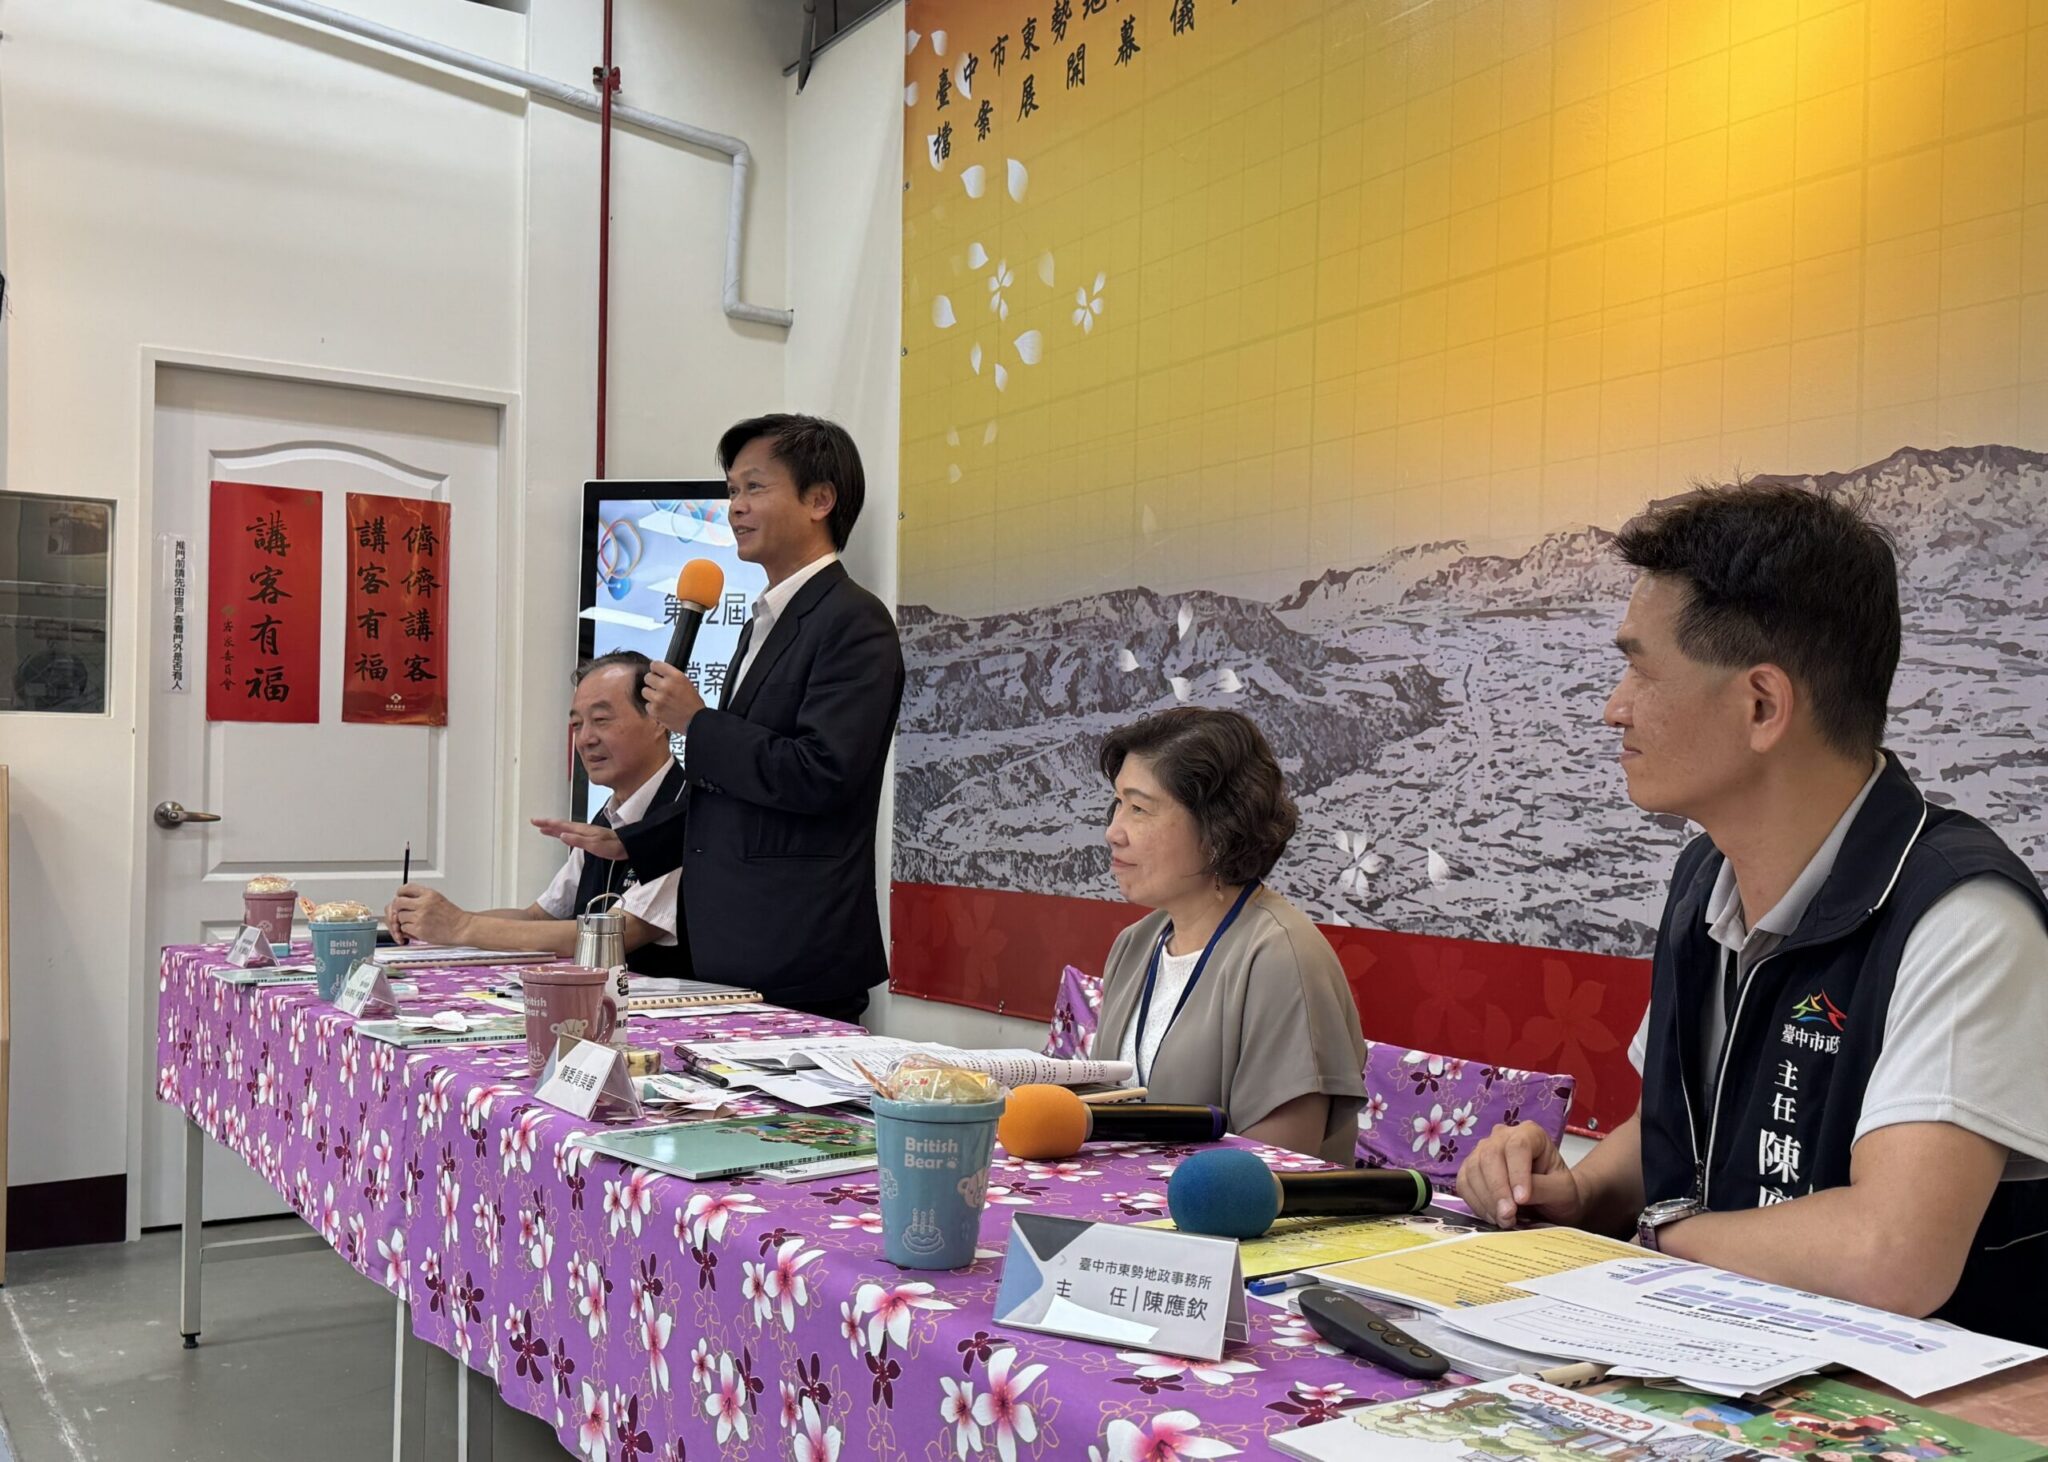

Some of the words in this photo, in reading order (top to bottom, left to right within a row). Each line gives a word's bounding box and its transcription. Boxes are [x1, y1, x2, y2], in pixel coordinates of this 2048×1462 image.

[936, 0, 1121, 111] 臺中市東勢地
[933, 0, 1236, 164] 檔案展開幕儀
[245, 510, 293, 703] 講客有福
[354, 515, 390, 683] 講客有福
[663, 593, 746, 626] 第2屆
[904, 1136, 958, 1153] British
[904, 1153, 945, 1168] Bear
[1079, 1256, 1213, 1291] 臺中市東勢地政事務所
[1142, 1289, 1209, 1321] 陳應欽
